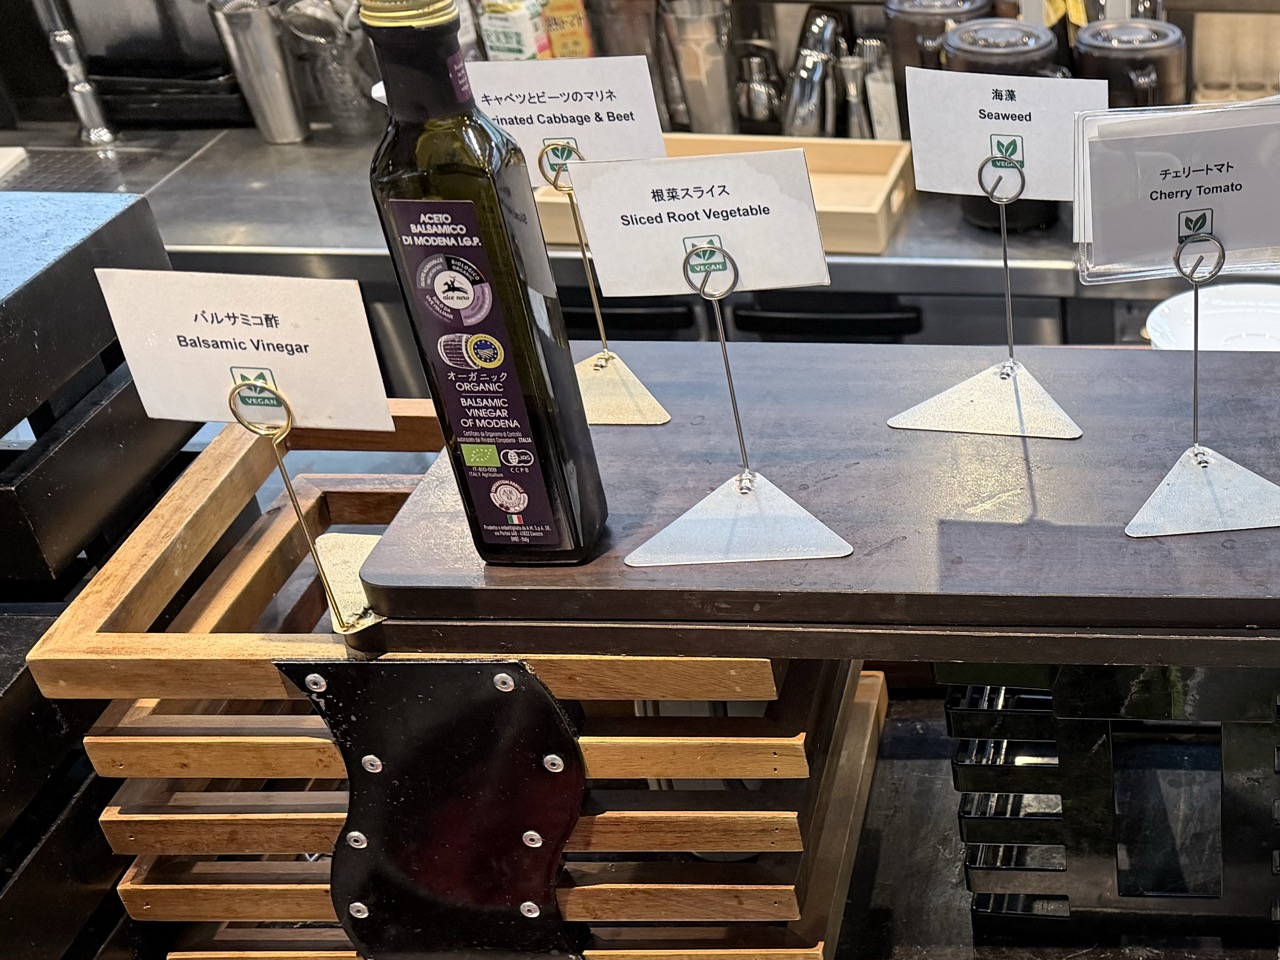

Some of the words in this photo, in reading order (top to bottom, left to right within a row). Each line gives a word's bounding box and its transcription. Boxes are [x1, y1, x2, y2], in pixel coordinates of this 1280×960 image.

[481, 89, 617, 107] キャベツとビーツのマリネ
[991, 88, 1017, 102] 海藻
[491, 114, 534, 126] inated
[537, 113, 591, 126] Cabbage
[594, 111, 604, 123] &
[607, 110, 635, 122] Beet
[978, 108, 1032, 122] Seaweed
[1159, 161, 1235, 181] チェリートマト
[651, 184, 730, 203] 根菜スライス
[1149, 185, 1193, 202] Cherry
[1197, 181, 1243, 197] Tomato
[420, 213, 452, 223] ACETO
[620, 212, 663, 227] Sliced
[668, 209, 701, 223] Root
[703, 204, 770, 221] Vegetable
[410, 223, 467, 234] BALSAMICO
[402, 235, 413, 245] DI
[413, 236, 458, 246] MODENA
[458, 236, 482, 246] I.G.P.
[451, 259, 480, 281] BIOLOGICO
[694, 263, 723, 272] VEGAN
[194, 309, 280, 329] バルサミコ酢
[176, 334, 247, 352] Balsamic
[250, 339, 310, 356] Vinegar
[447, 371, 507, 382] オーガニック
[455, 382, 504, 392] ORGANIC
[245, 397, 278, 406] VEGAN
[460, 398, 509, 407] BALSAMIC
[465, 408, 509, 418] VINEGAR
[460, 418, 475, 428] OF
[476, 418, 521, 428] MODENA
